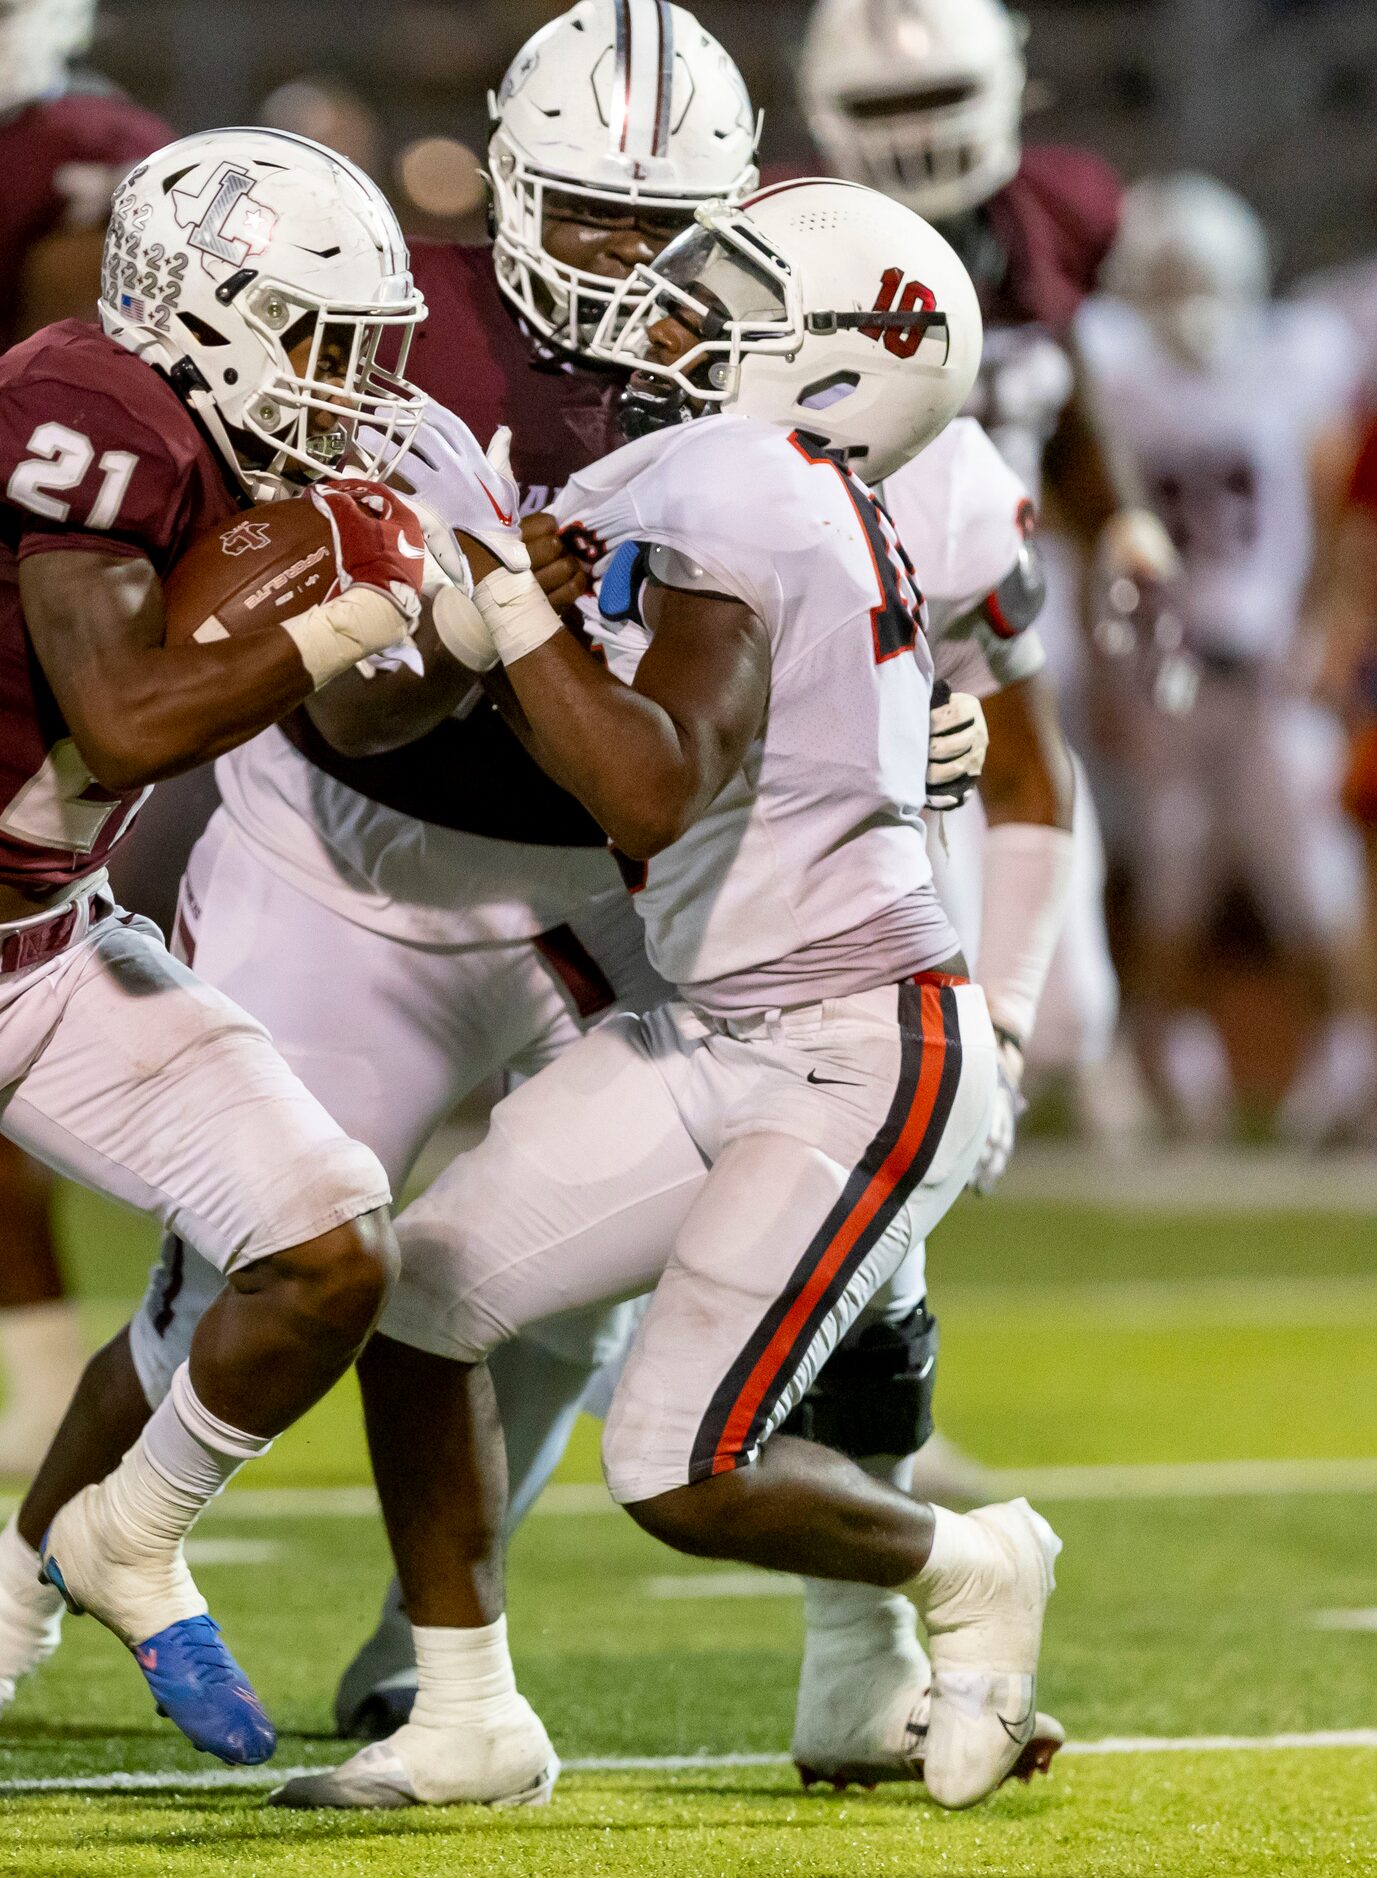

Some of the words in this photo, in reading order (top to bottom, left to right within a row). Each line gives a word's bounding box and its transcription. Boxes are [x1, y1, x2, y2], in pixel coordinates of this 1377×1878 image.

[857, 266, 937, 360] 10
[6, 421, 141, 530] 21
[244, 571, 289, 610] ELITE
